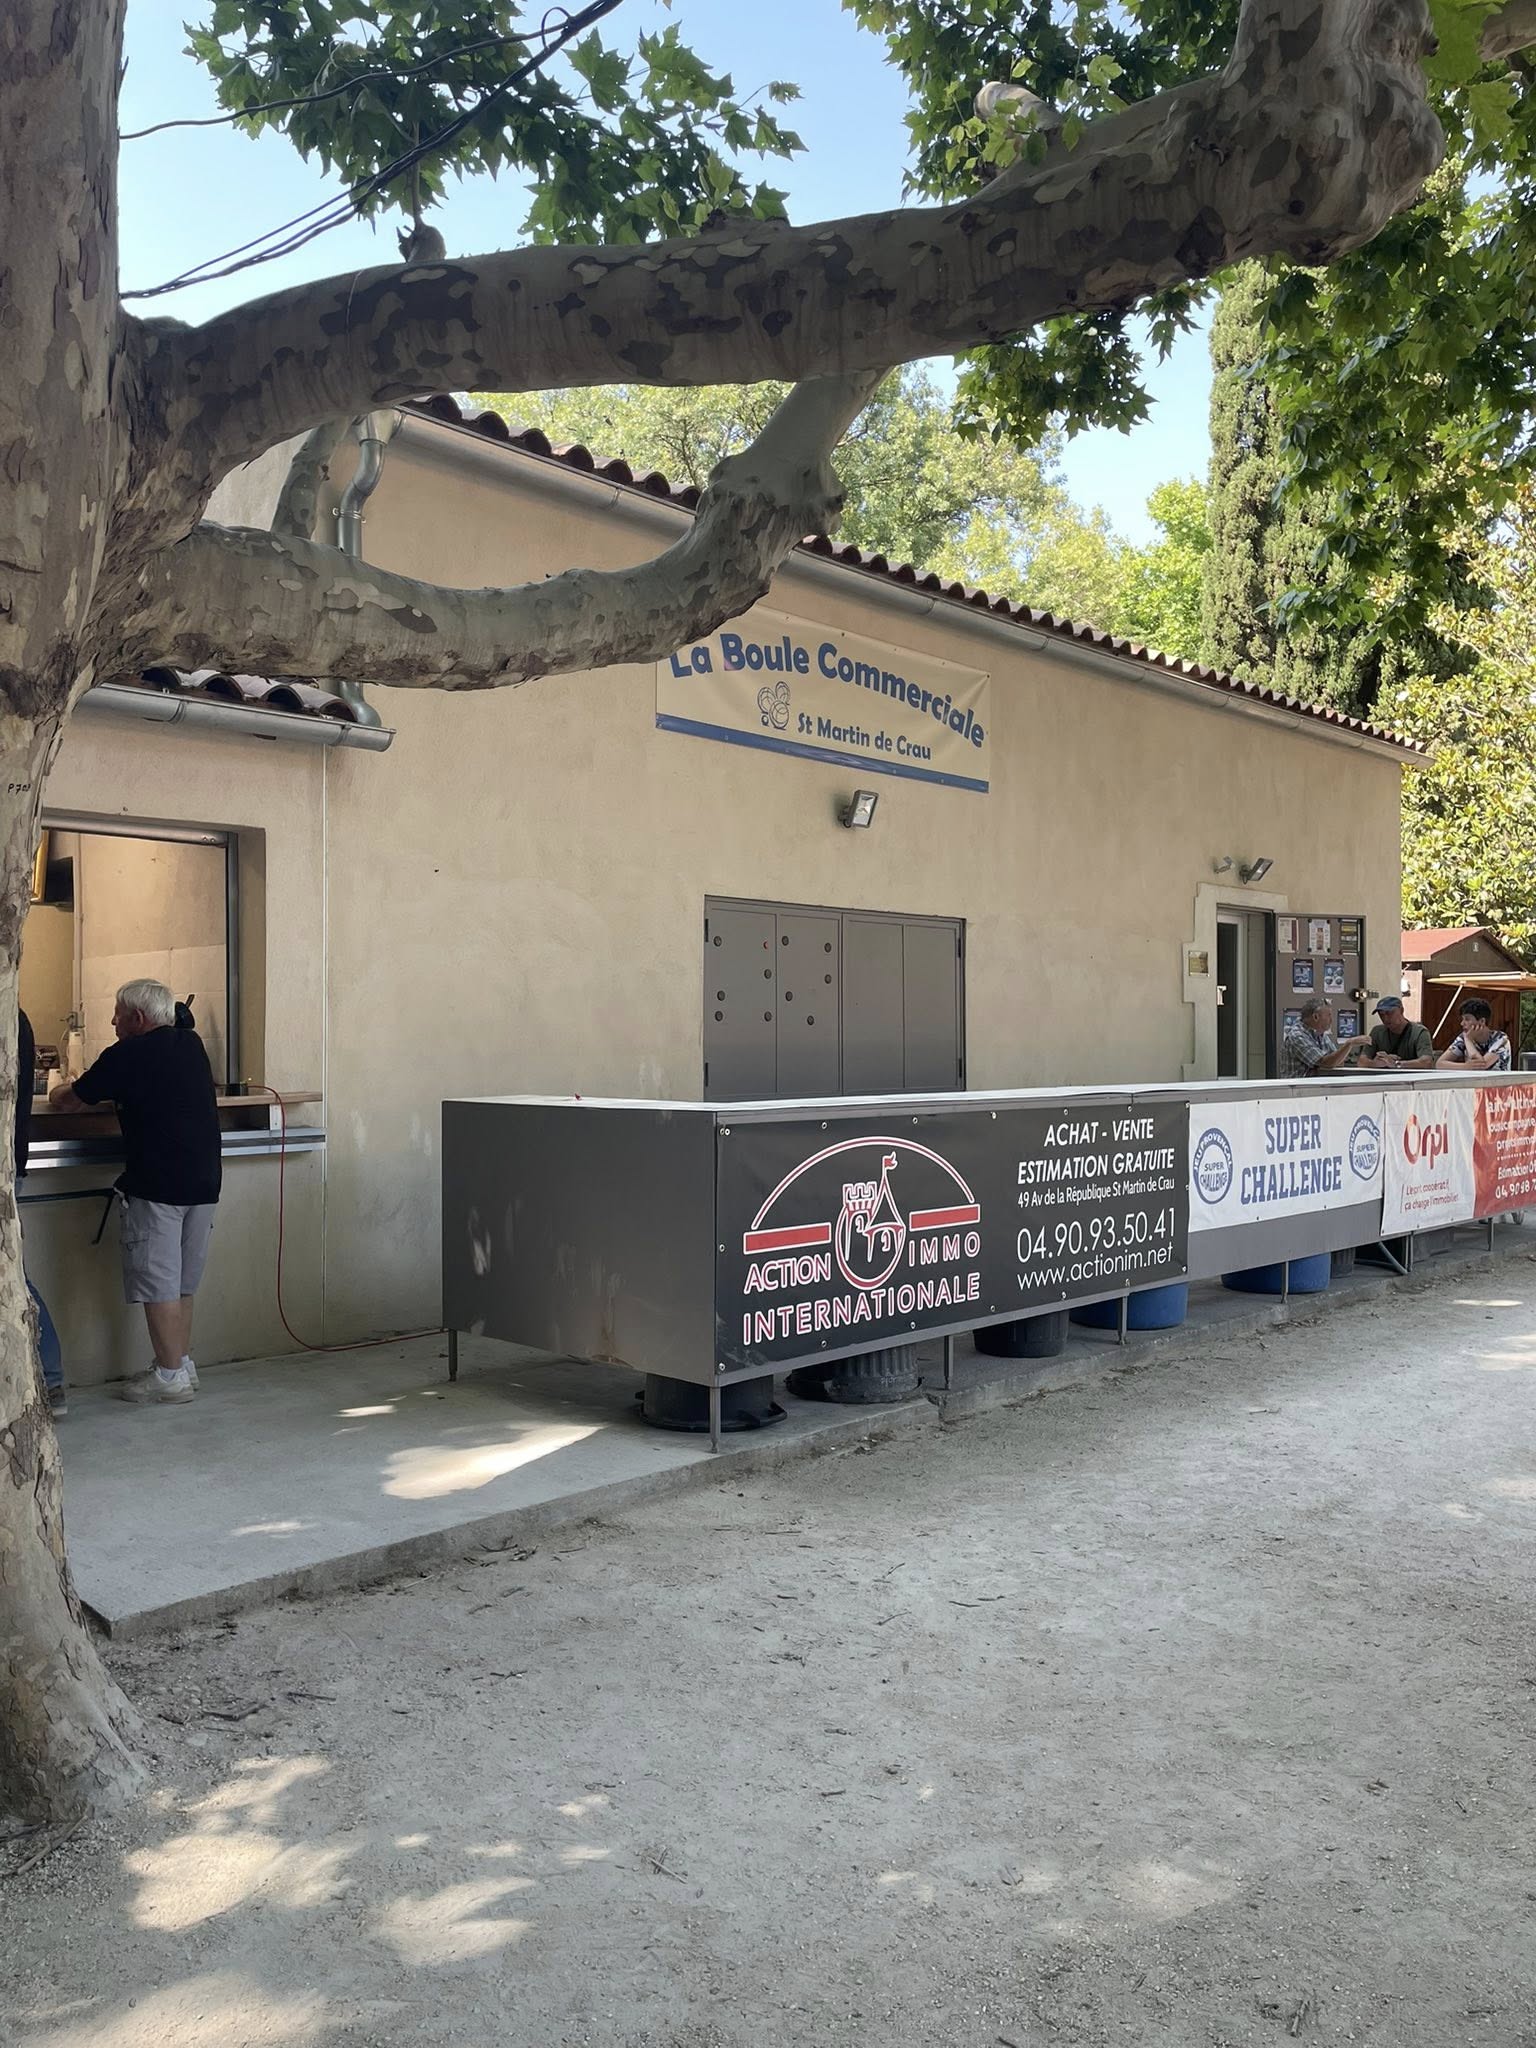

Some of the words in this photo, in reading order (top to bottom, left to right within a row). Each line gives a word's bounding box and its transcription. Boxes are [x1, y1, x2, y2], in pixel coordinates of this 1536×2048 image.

[669, 646, 712, 679] La
[719, 633, 810, 673] Boule
[817, 642, 985, 748] Commerciale
[798, 712, 813, 734] St
[817, 717, 870, 747] Martin
[874, 731, 892, 751] de
[896, 736, 931, 760] Crau
[1044, 1122, 1099, 1147] ACHAT
[1113, 1118, 1154, 1141] VENTE
[1264, 1114, 1322, 1155] SUPER
[1404, 1109, 1448, 1170] Orpi
[1018, 1154, 1108, 1184] ESTIMATION
[1113, 1148, 1174, 1174] GRATUITE
[1194, 1149, 1203, 1171] JEU
[1200, 1172, 1228, 1192] CHALLENGE
[1204, 1162, 1224, 1172] SUPER
[1240, 1156, 1342, 1206] CHALLENGE
[1018, 1191, 1029, 1208] 49
[1031, 1191, 1043, 1207] Av
[1044, 1189, 1055, 1205] de
[1057, 1188, 1064, 1203] la
[1066, 1184, 1110, 1206] République
[1113, 1182, 1121, 1196] St
[1122, 1178, 1145, 1195] Martin
[1147, 1177, 1157, 1191] de
[1158, 1176, 1174, 1190] Crau
[1495, 1185, 1508, 1198] 04
[1017, 1208, 1174, 1263] 04.90.93.50.41
[744, 1253, 831, 1294] ACTION
[909, 1231, 980, 1267] IMMO
[1017, 1242, 1173, 1290] www.actionim.net
[743, 1272, 980, 1345] INTERNATIONALE
